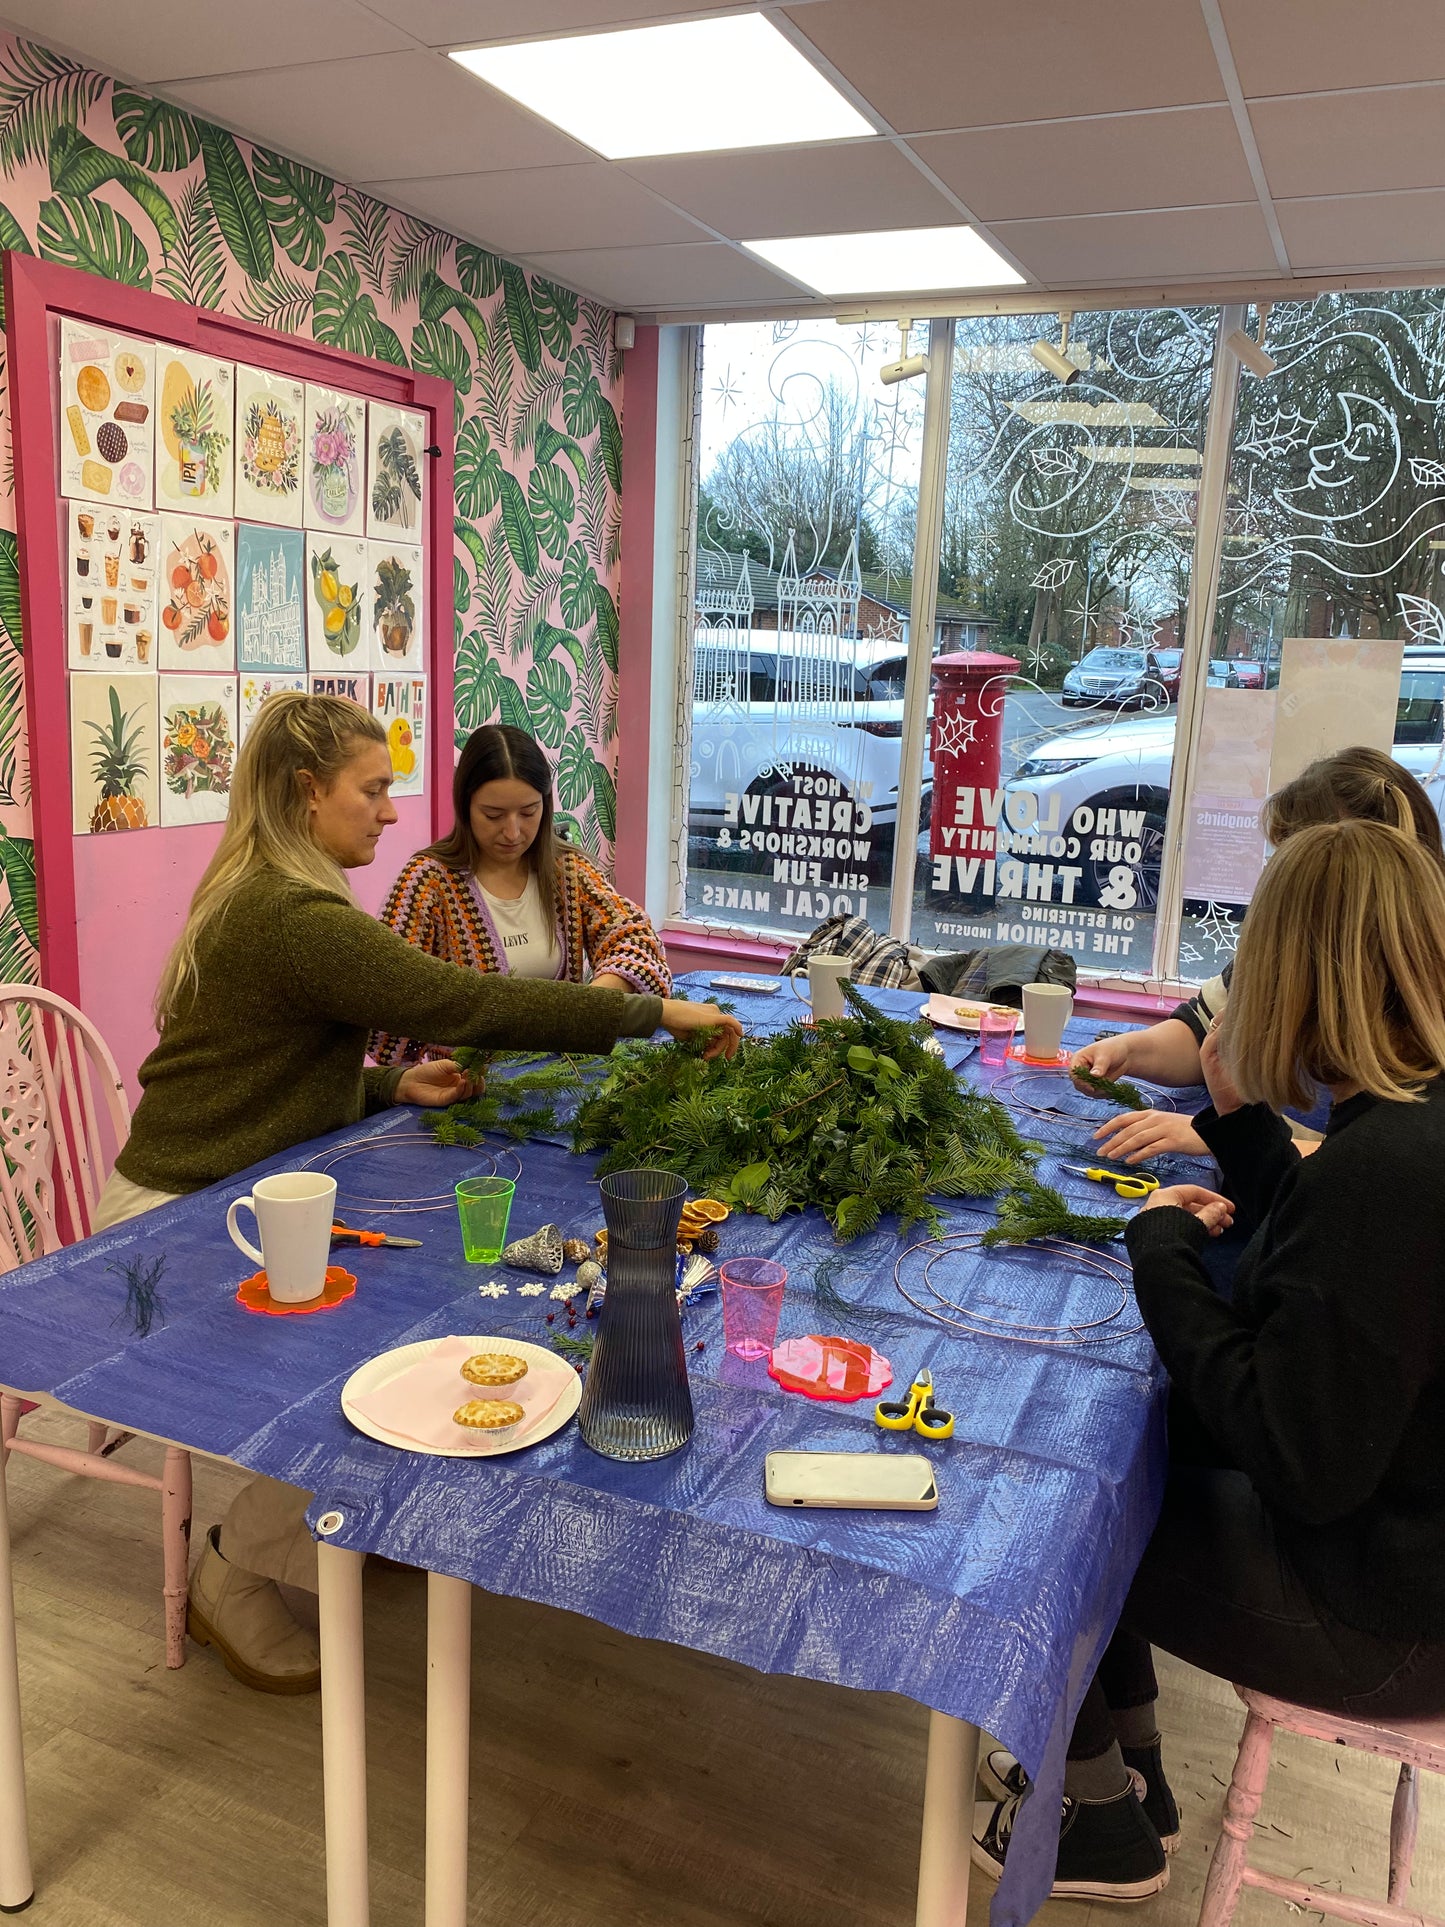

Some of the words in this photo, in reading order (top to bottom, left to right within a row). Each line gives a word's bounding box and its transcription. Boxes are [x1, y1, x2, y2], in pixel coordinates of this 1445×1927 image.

[262, 437, 283, 450] BEES
[259, 447, 285, 459] KNEES
[183, 462, 197, 484] IPA
[377, 682, 409, 715] BATH
